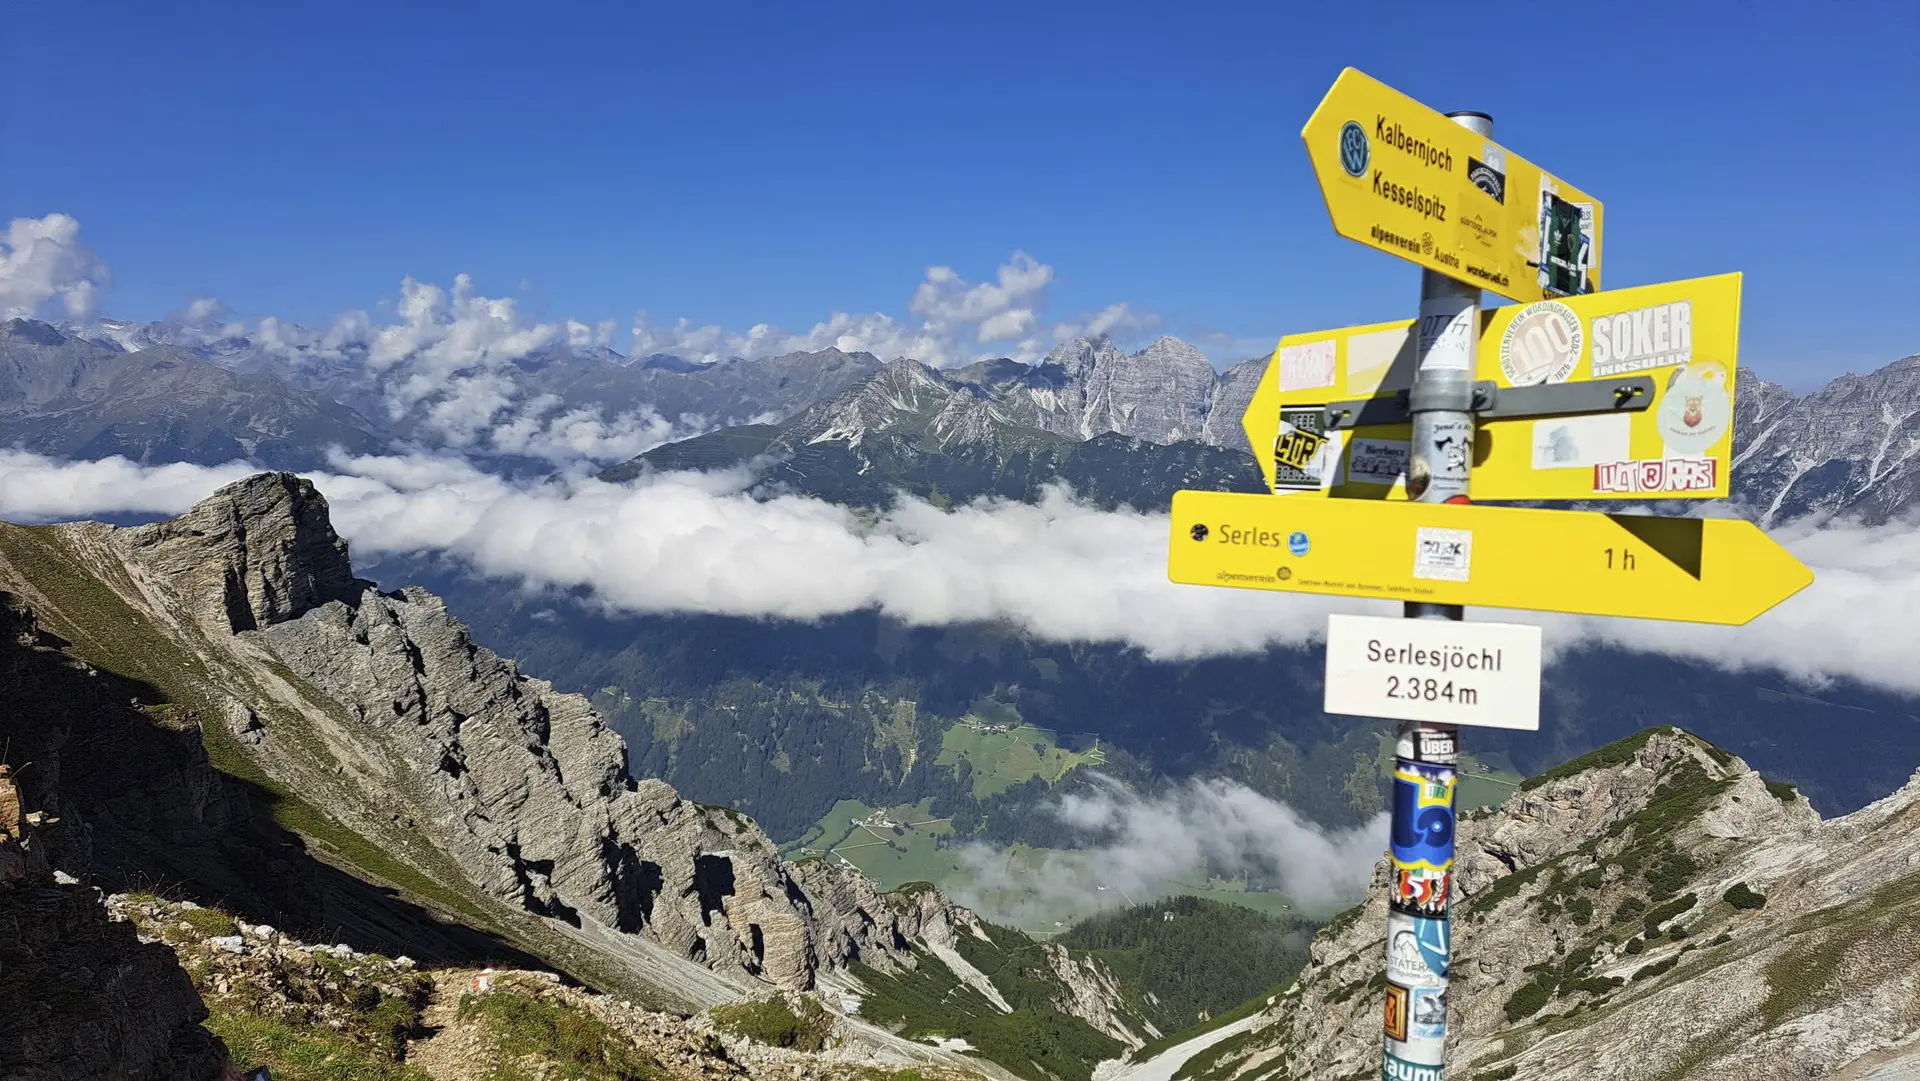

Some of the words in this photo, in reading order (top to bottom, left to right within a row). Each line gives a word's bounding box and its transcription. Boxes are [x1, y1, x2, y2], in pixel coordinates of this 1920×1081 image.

[1376, 114, 1452, 172] Kalbernjoch
[1373, 168, 1446, 222] Kesselspitz
[1371, 223, 1421, 254] alpenverein
[1434, 246, 1460, 268] Austria
[1593, 302, 1691, 363] SOKER
[1219, 524, 1280, 548] Serles
[1603, 548, 1613, 569] 1
[1622, 548, 1636, 570] h
[1367, 639, 1502, 672] Serlesjöchl
[1420, 738, 1454, 755] ÜBER
